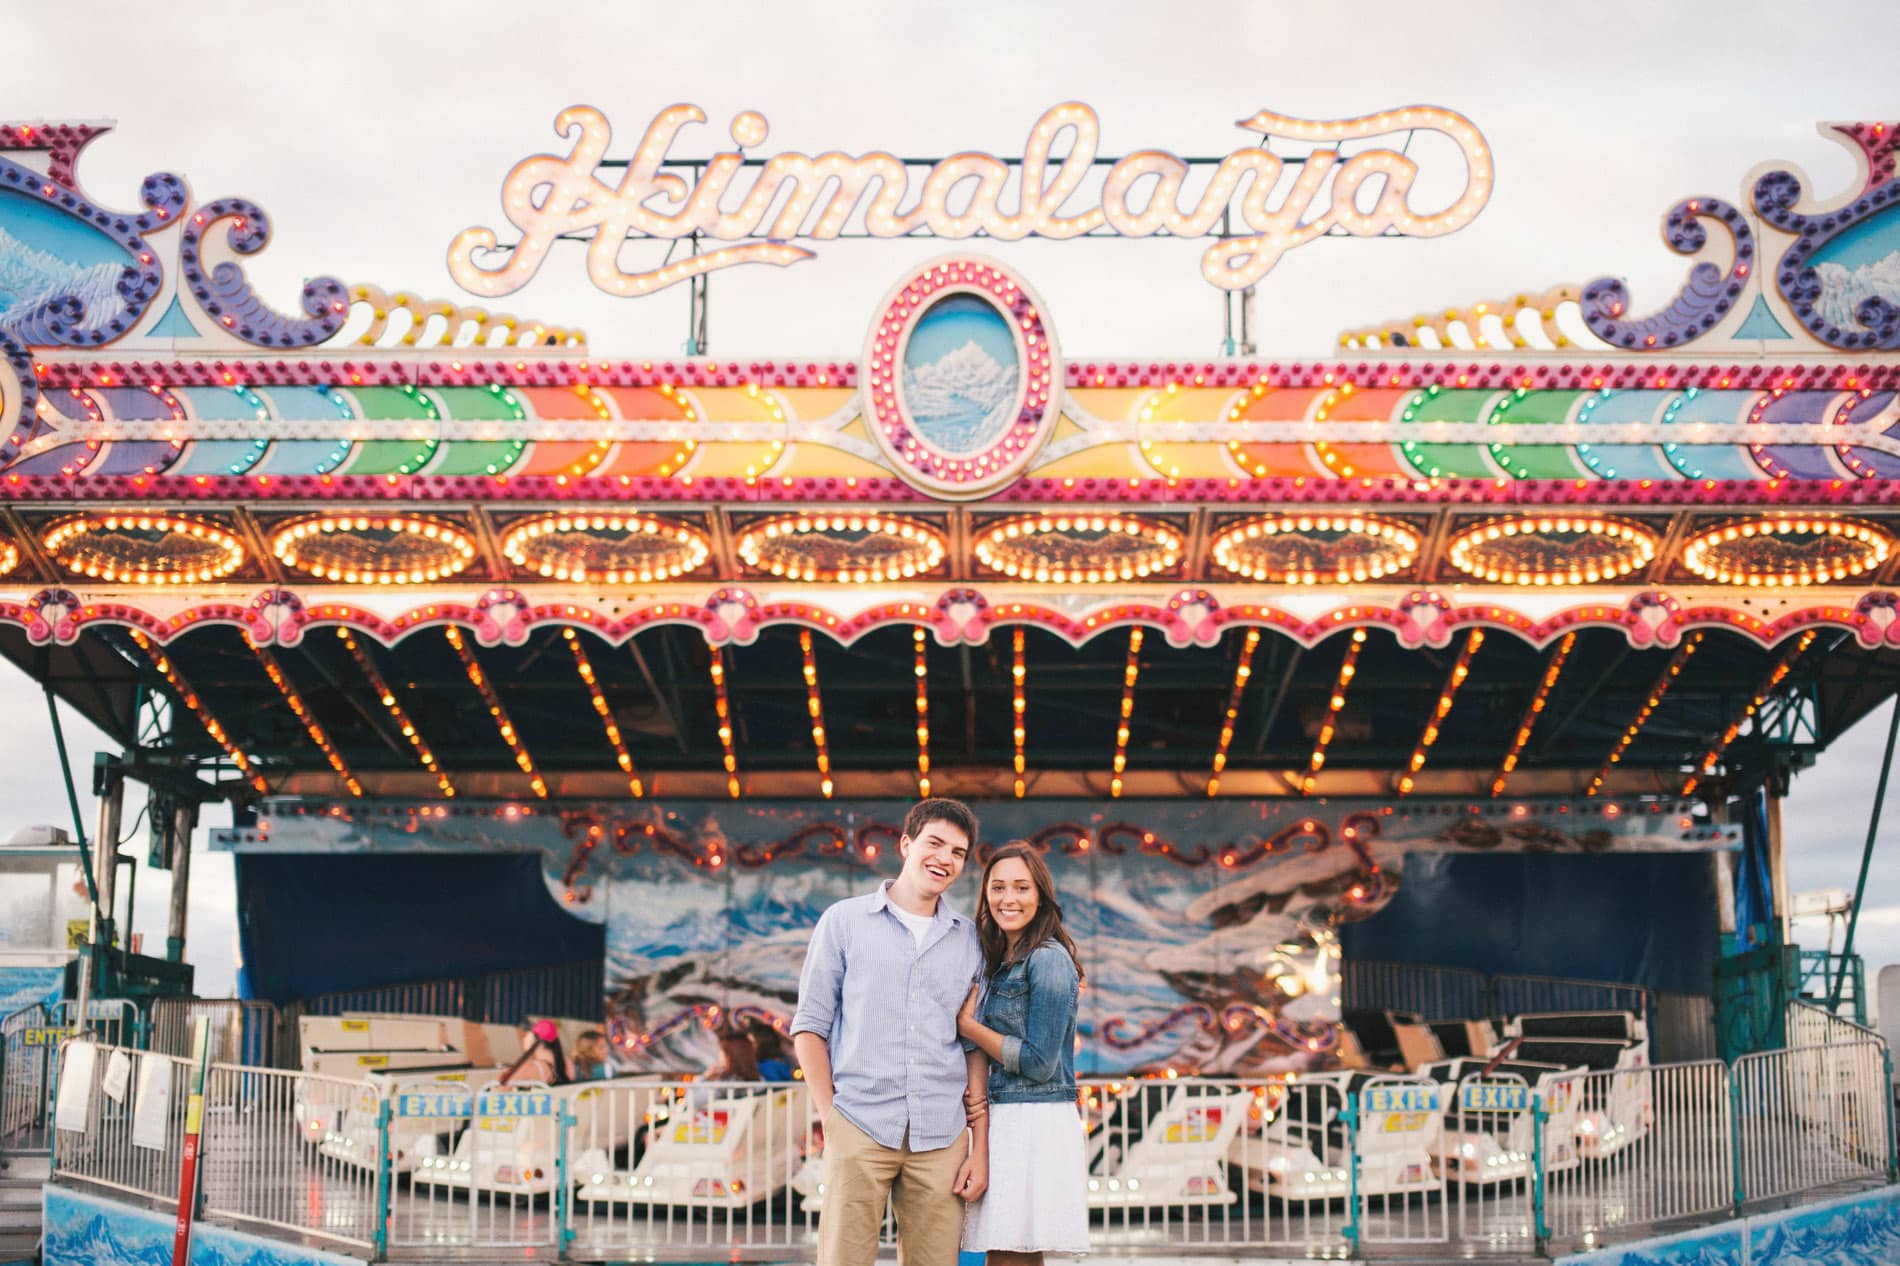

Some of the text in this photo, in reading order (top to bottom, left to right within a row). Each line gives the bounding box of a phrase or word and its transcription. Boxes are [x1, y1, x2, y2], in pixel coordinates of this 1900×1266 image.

[447, 101, 1495, 297] Himalaya
[406, 1096, 466, 1115] EXIT
[486, 1095, 547, 1115] EXIT
[1372, 1090, 1432, 1110] EXIT
[1470, 1087, 1523, 1106] EXIT
